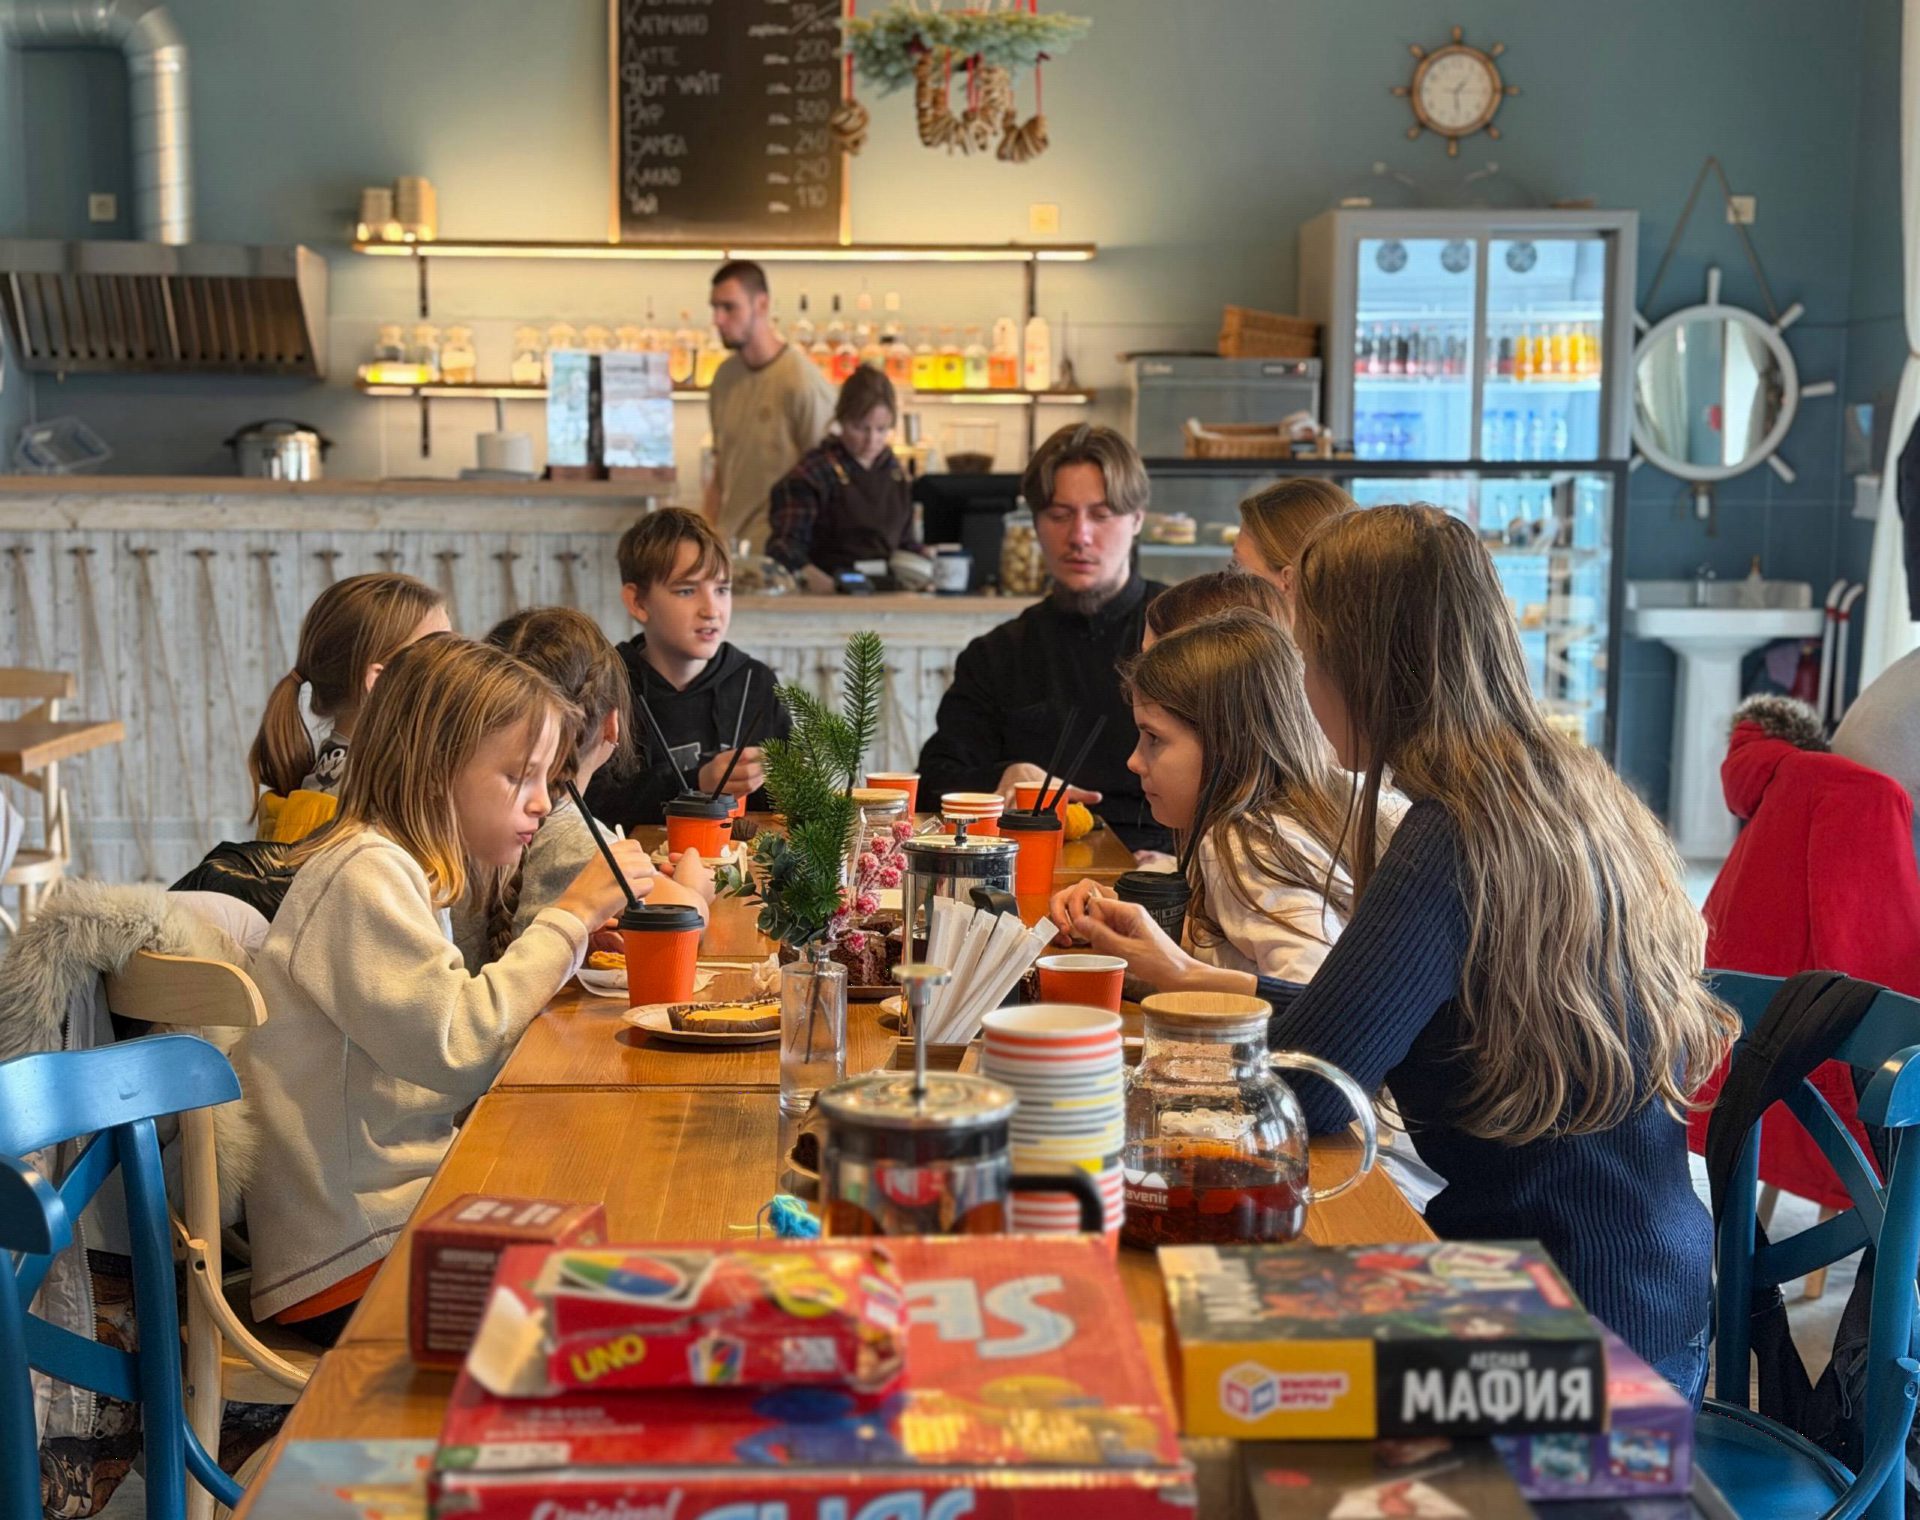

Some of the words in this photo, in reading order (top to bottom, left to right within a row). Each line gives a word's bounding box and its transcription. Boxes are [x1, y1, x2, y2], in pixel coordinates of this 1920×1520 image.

[795, 69, 831, 92] 220
[570, 1333, 645, 1382] UNO
[1402, 1367, 1592, 1423] МАФИЯ
